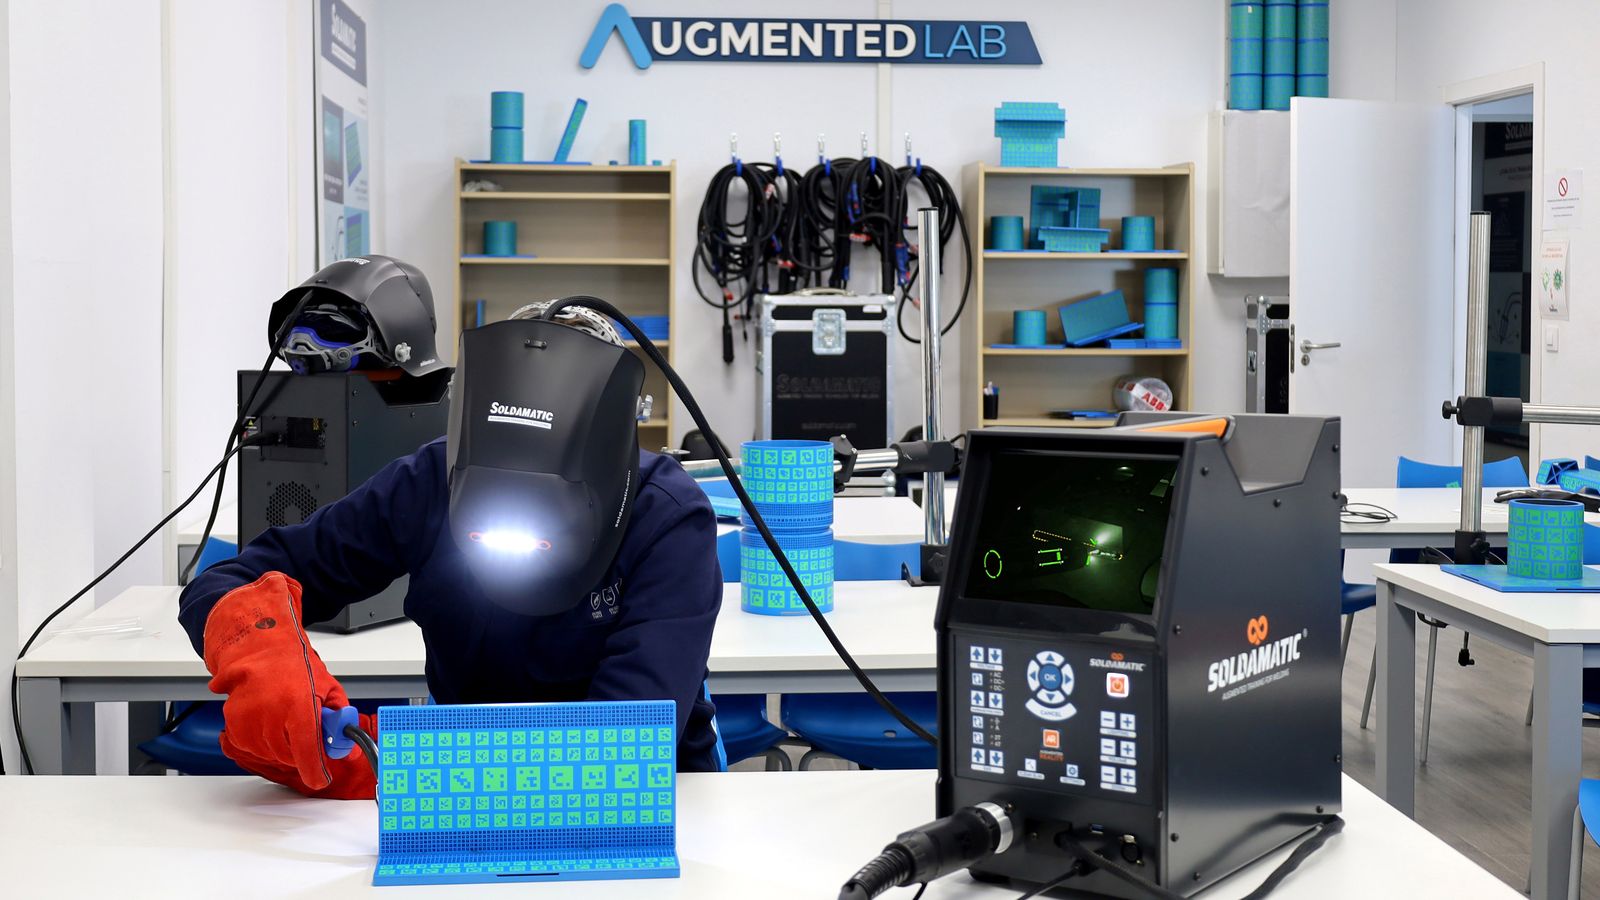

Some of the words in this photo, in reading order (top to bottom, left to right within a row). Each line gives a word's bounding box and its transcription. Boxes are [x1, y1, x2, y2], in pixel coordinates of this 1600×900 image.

[578, 3, 917, 70] AUGMENTED
[925, 24, 1007, 58] LAB
[1141, 391, 1165, 410] ABB
[489, 401, 554, 421] SOLDAMATIC
[614, 469, 631, 528] soldamatic.com
[1089, 658, 1145, 671] SOLDAMATIC
[1207, 632, 1302, 692] SOLDAMATIC
[1043, 673, 1057, 682] OK
